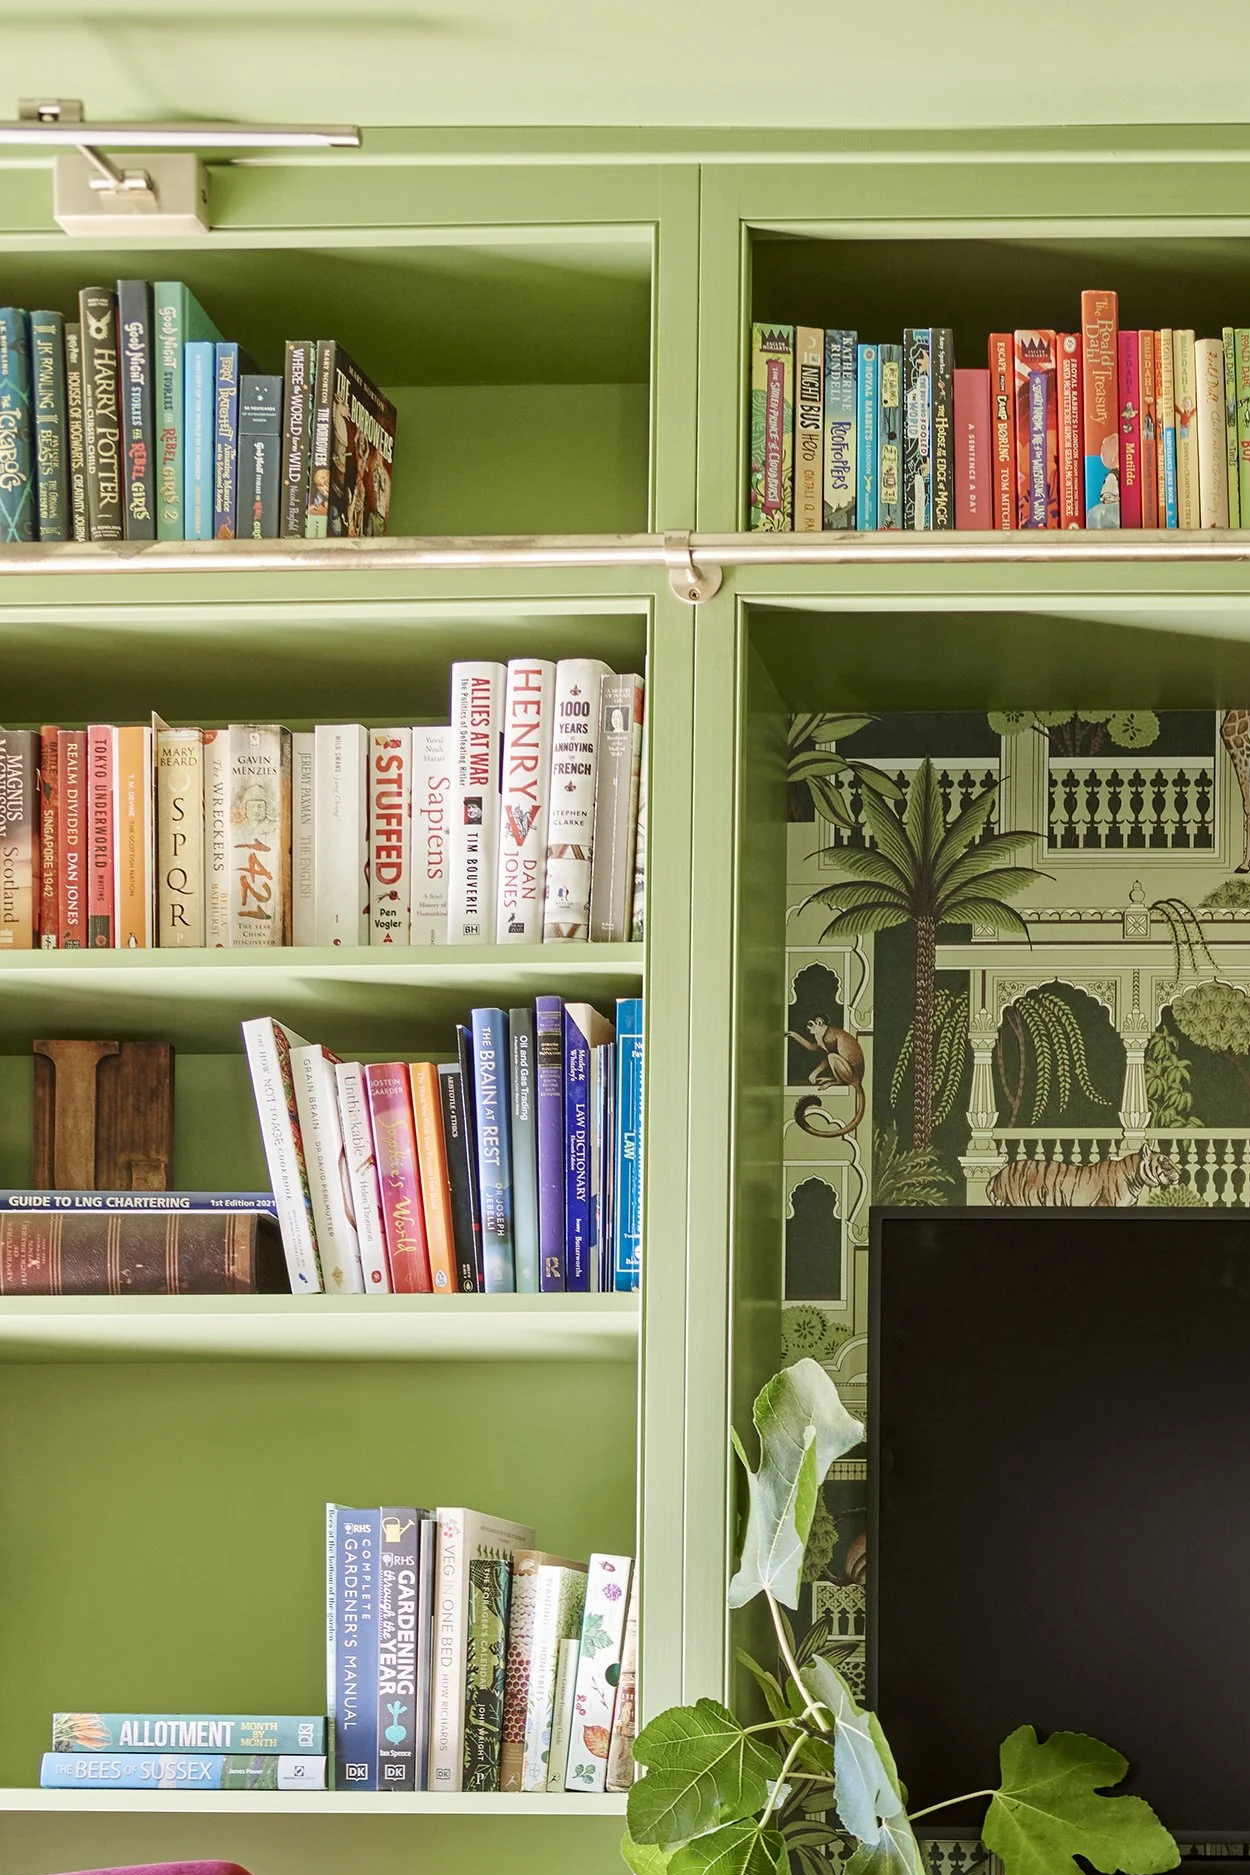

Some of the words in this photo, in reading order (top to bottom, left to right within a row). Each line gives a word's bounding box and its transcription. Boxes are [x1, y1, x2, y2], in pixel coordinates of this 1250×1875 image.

[1095, 300, 1108, 316] The
[1085, 323, 1099, 363] Dahl
[1097, 319, 1115, 364] Roald
[95, 347, 117, 421] HARRY
[220, 352, 234, 384] TERRY
[830, 344, 841, 403] RUNDELL
[842, 337, 853, 412] KATHERINE
[218, 388, 234, 441] PRATCHETT
[317, 408, 329, 422] THE
[336, 368, 351, 406] THE
[351, 395, 393, 464] BORROWERS
[1091, 369, 1112, 426] Treasury
[39, 429, 53, 476] BEASTS
[316, 423, 329, 466] BORROWERS
[1126, 443, 1135, 486] Matilda
[98, 428, 119, 512] POTTER
[470, 677, 490, 727] ALLIES
[559, 701, 590, 718] 1000
[470, 729, 489, 748] AT
[559, 723, 588, 735] YEARS
[94, 738, 107, 778] TOKYO
[160, 756, 198, 766] BEARD
[162, 747, 195, 758] MARY
[469, 752, 489, 786] WAR
[553, 763, 592, 776] FRENCH
[94, 784, 108, 869] UNDERWORLD
[375, 754, 404, 886] STUFFED
[419, 776, 450, 880] Sapiens
[2, 846, 19, 924] Scotland
[503, 851, 519, 908] JONES
[379, 908, 397, 917] Pen
[482, 1026, 490, 1047] THE
[479, 1050, 496, 1105] BRAIN
[344, 1076, 363, 1157] Unthinkable
[486, 1108, 495, 1121] AT
[576, 1103, 585, 1129] LAW
[482, 1125, 500, 1167] REST
[576, 1130, 586, 1202] DICTIONARY
[8, 1196, 51, 1207] GUIDE
[54, 1197, 72, 1207] TO
[75, 1197, 102, 1208] LNG
[106, 1197, 190, 1209] CHARTERING
[210, 1199, 223, 1207] 1st
[225, 1199, 255, 1207] Edition
[256, 1199, 276, 1207] 2021
[353, 1523, 372, 1534] RHS
[361, 1538, 371, 1621] COMPLETE
[393, 1555, 415, 1565] RHS
[344, 1538, 358, 1648] GARDENER'S
[396, 1570, 415, 1696] GARDENING
[344, 1655, 357, 1730] MANUAL
[118, 1720, 235, 1748] ALLOTMENT
[240, 1722, 278, 1731] MONTH
[240, 1738, 277, 1747] MONTH
[55, 1764, 72, 1775] THE
[75, 1761, 122, 1779] BEES
[124, 1765, 138, 1775] OF
[141, 1762, 212, 1781] SUSSEX
